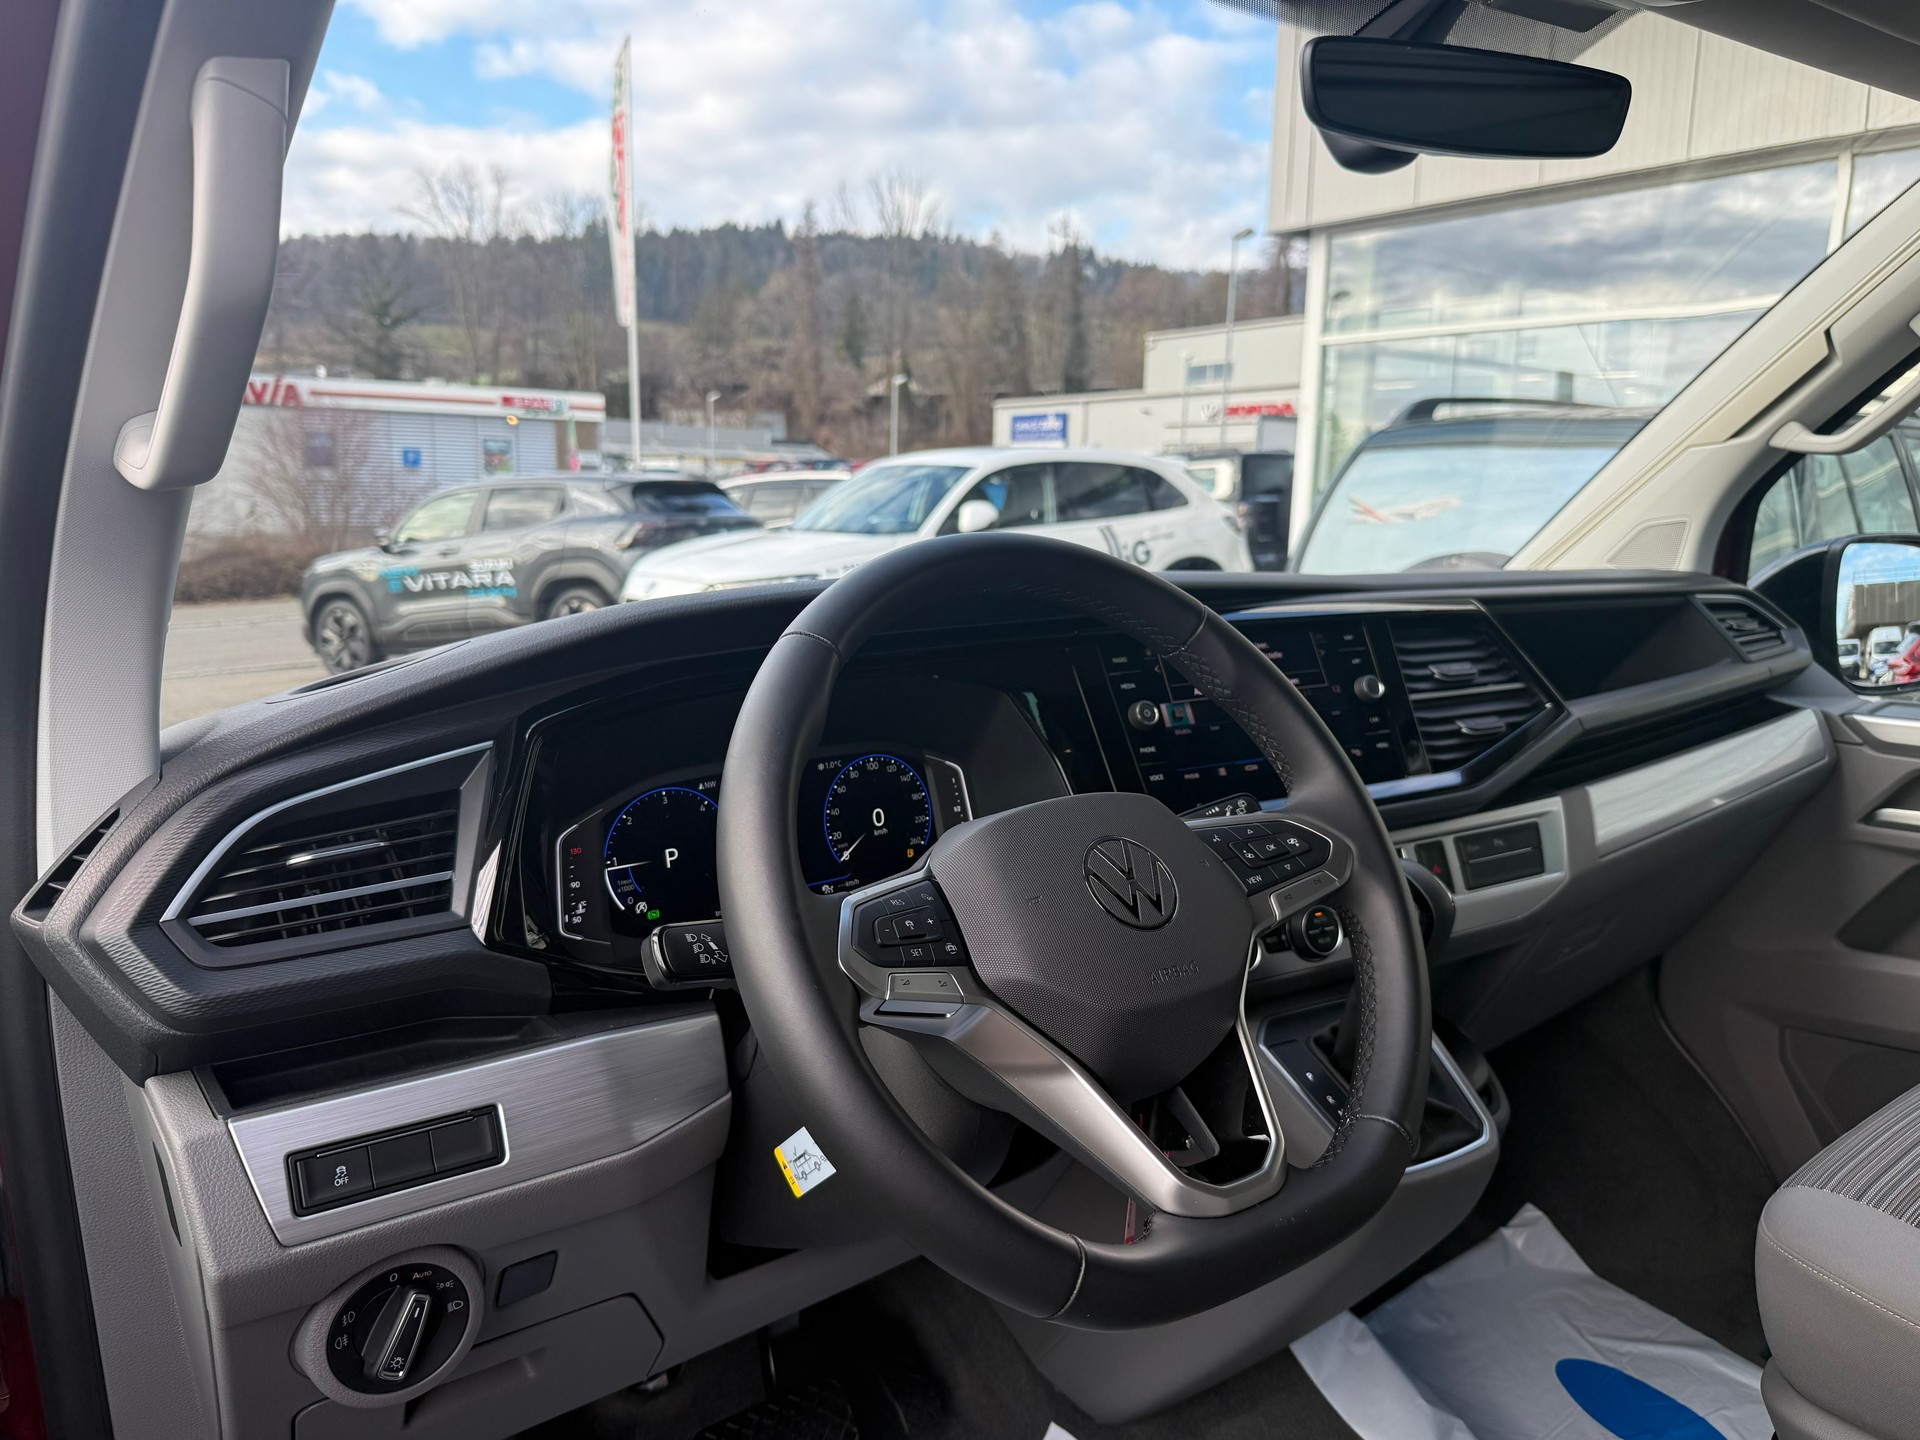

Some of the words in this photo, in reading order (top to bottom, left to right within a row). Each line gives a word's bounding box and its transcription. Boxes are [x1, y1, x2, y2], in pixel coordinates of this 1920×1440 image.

[402, 570, 516, 593] VITARA
[866, 761, 879, 771] 100
[886, 765, 898, 773] 120
[850, 770, 859, 779] 80
[900, 774, 911, 782] 140
[1149, 773, 1165, 782] VOICE
[704, 780, 717, 788] NW
[837, 785, 847, 794] 60
[662, 796, 668, 805] 3
[699, 804, 706, 812] 4
[830, 808, 840, 816] 40
[626, 816, 633, 826] 2
[872, 807, 885, 827] 0
[914, 814, 926, 824] 220
[832, 831, 842, 840] 20
[873, 827, 889, 836] km/h
[909, 837, 922, 846] 260
[569, 847, 582, 855] 130
[1265, 843, 1278, 852] OK
[664, 847, 679, 869] P
[1246, 873, 1263, 885] VIEW
[570, 880, 581, 889] 90
[627, 896, 634, 905] 0
[890, 899, 906, 907] RES
[572, 915, 582, 924] 50
[910, 948, 923, 957] SET
[1150, 961, 1200, 984] AIRBAG
[334, 1177, 349, 1187] OFF
